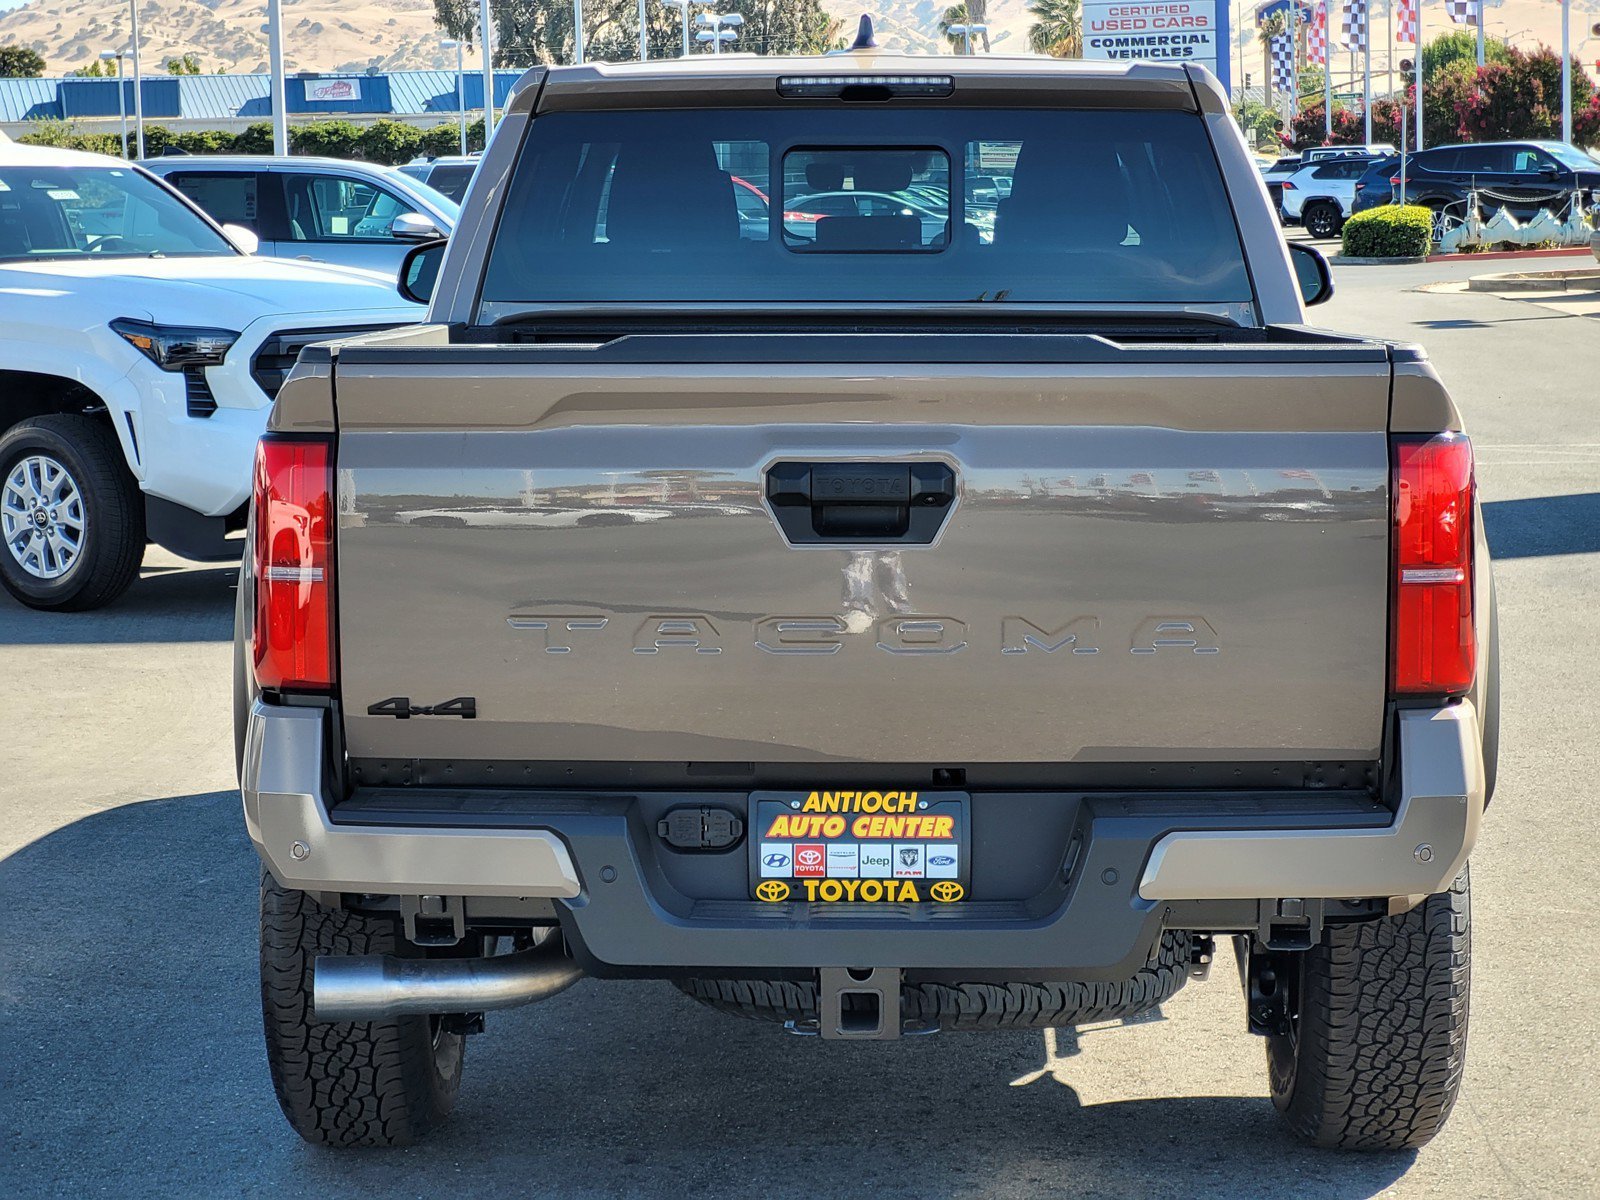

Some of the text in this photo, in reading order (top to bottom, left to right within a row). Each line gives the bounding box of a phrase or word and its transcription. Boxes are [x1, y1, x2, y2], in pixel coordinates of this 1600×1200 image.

[1108, 4, 1190, 17] CERTIFIED
[1091, 16, 1209, 32] USED CARS
[1090, 34, 1210, 48] COMMERCIAL
[1107, 47, 1194, 59] VEHICLES
[817, 477, 905, 494] TOYOTA
[507, 615, 1220, 655] TACOMA
[802, 791, 918, 813] ANTIOCH
[765, 815, 954, 838] AUTO CENTER
[861, 856, 890, 867] Jeep
[932, 857, 951, 865] Ford
[803, 880, 920, 902] TOYOTA
